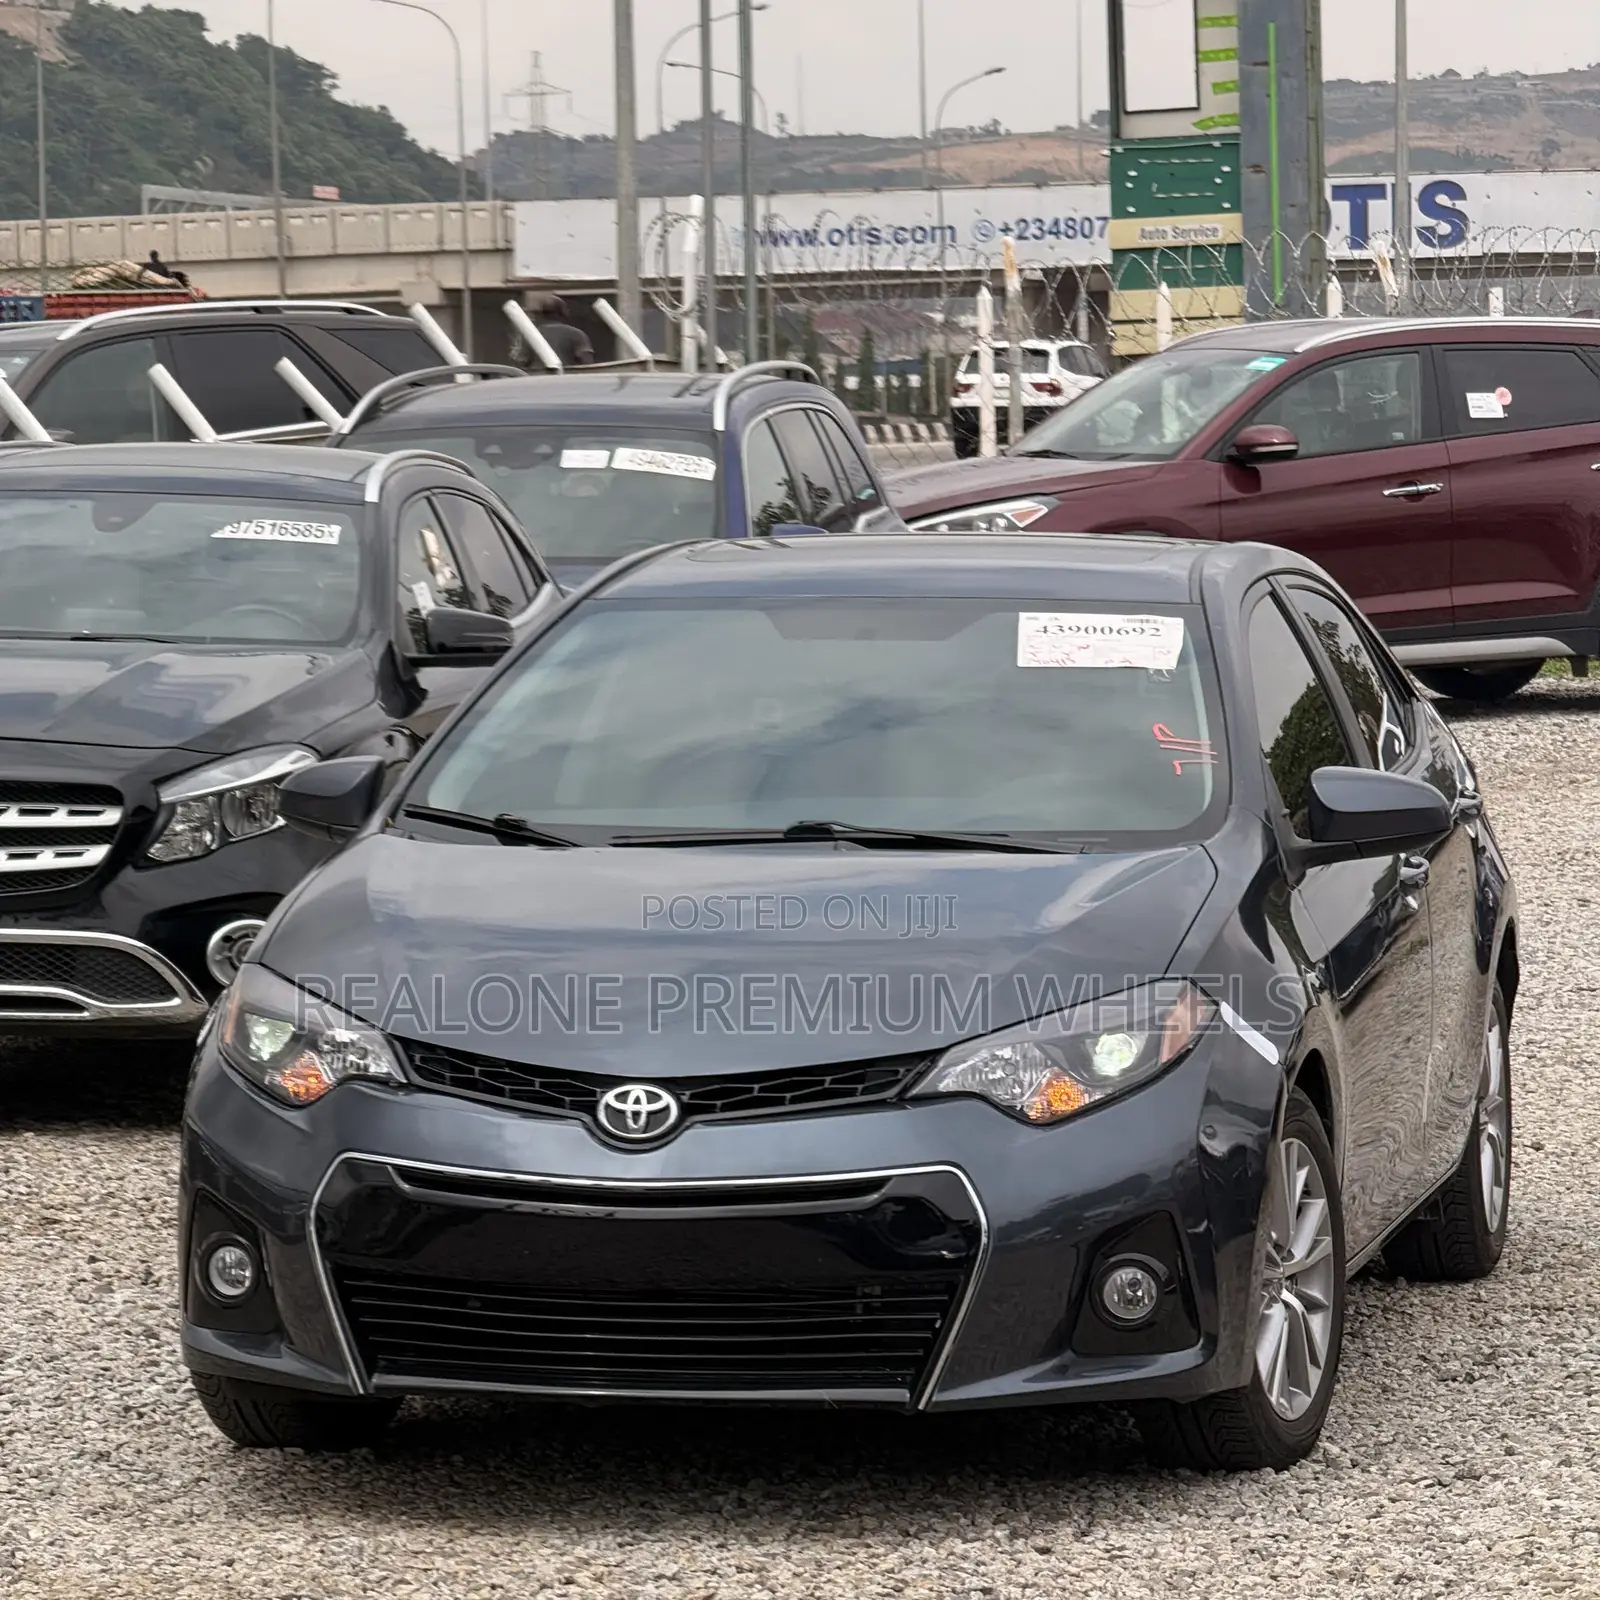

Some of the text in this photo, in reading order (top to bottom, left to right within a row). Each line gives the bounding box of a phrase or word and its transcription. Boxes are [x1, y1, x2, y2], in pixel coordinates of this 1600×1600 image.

[998, 215, 1110, 240] +234807
[1139, 224, 1220, 242] Auto Service
[1034, 624, 1162, 637] 43900692
